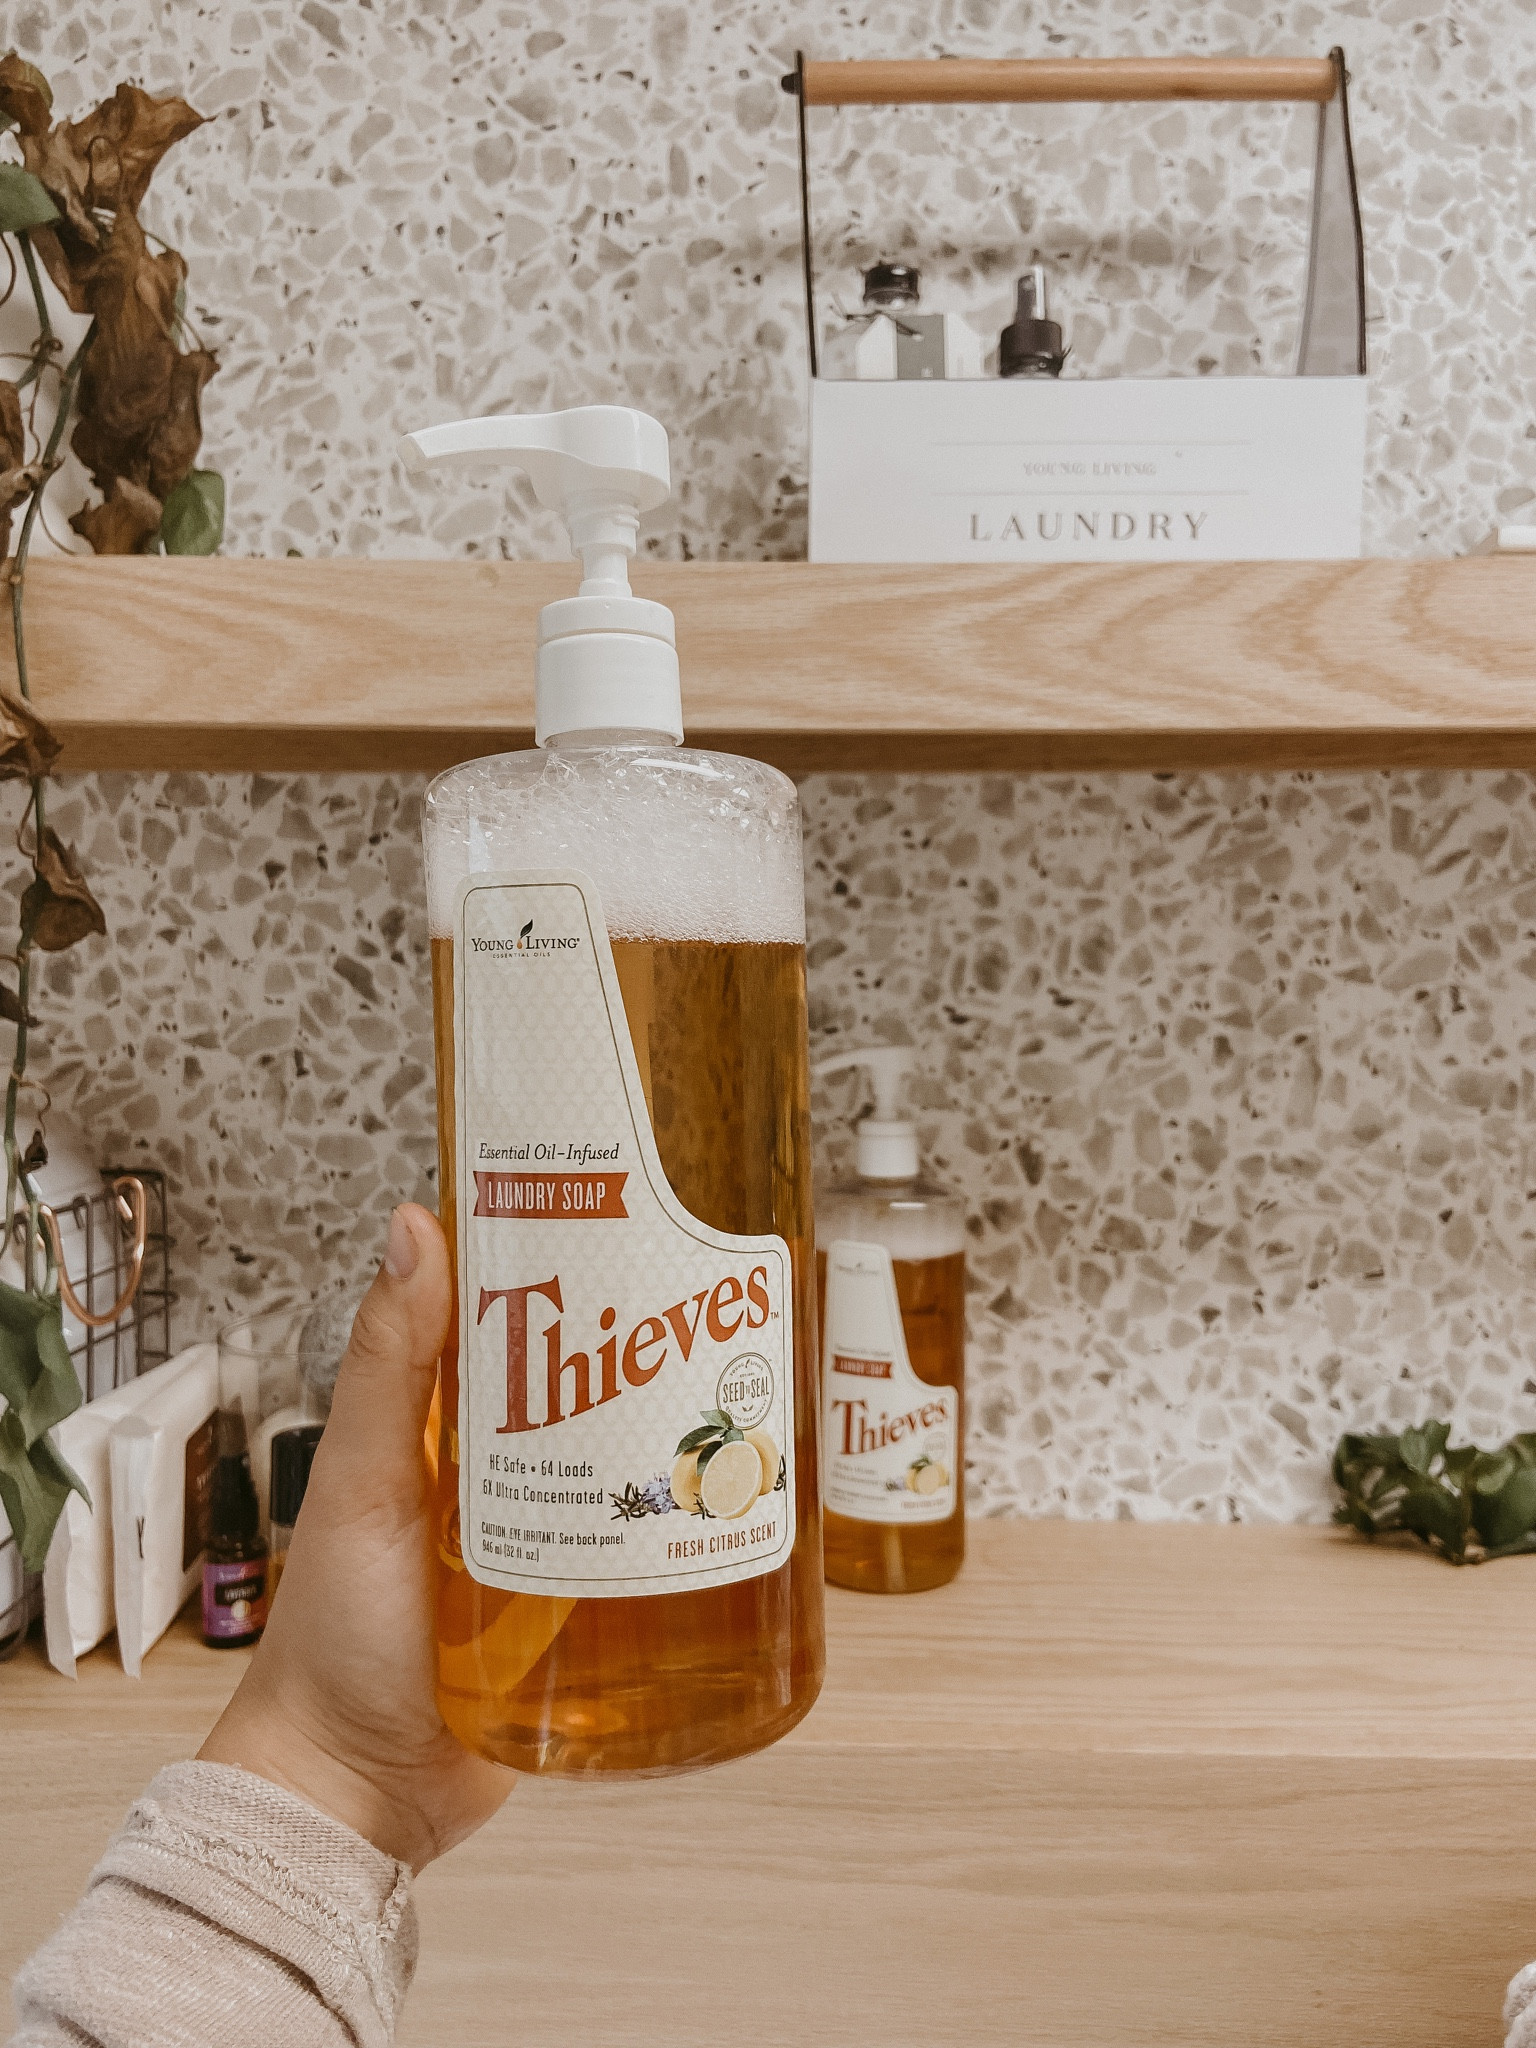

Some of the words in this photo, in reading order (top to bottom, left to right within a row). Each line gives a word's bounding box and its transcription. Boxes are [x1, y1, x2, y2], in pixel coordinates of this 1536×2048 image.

[970, 512, 1208, 541] LAUNDRY
[471, 937, 514, 951] YOUNG
[479, 1142, 530, 1160] Essential
[488, 1181, 556, 1210] LAUNDRY
[562, 1181, 606, 1211] SOAP
[477, 1265, 770, 1434] Thieves
[722, 1381, 745, 1403] SEED
[751, 1375, 770, 1399] SEAL
[830, 1397, 948, 1456] Thieves
[489, 1453, 501, 1471] HE
[504, 1456, 526, 1475] Safe
[541, 1459, 553, 1477] 64
[558, 1460, 594, 1478] Loads
[483, 1478, 493, 1496] 6X
[496, 1481, 519, 1501] Ultra
[523, 1485, 604, 1505] Concentrated
[482, 1539, 493, 1554] 946
[503, 1542, 515, 1558] (32
[509, 1527, 521, 1541] EYE
[559, 1532, 574, 1545] See
[577, 1532, 597, 1546] back
[600, 1532, 626, 1548] panel.
[668, 1538, 704, 1560] FRESH
[709, 1530, 746, 1554] CITRUS
[750, 1520, 776, 1545] SCENT
